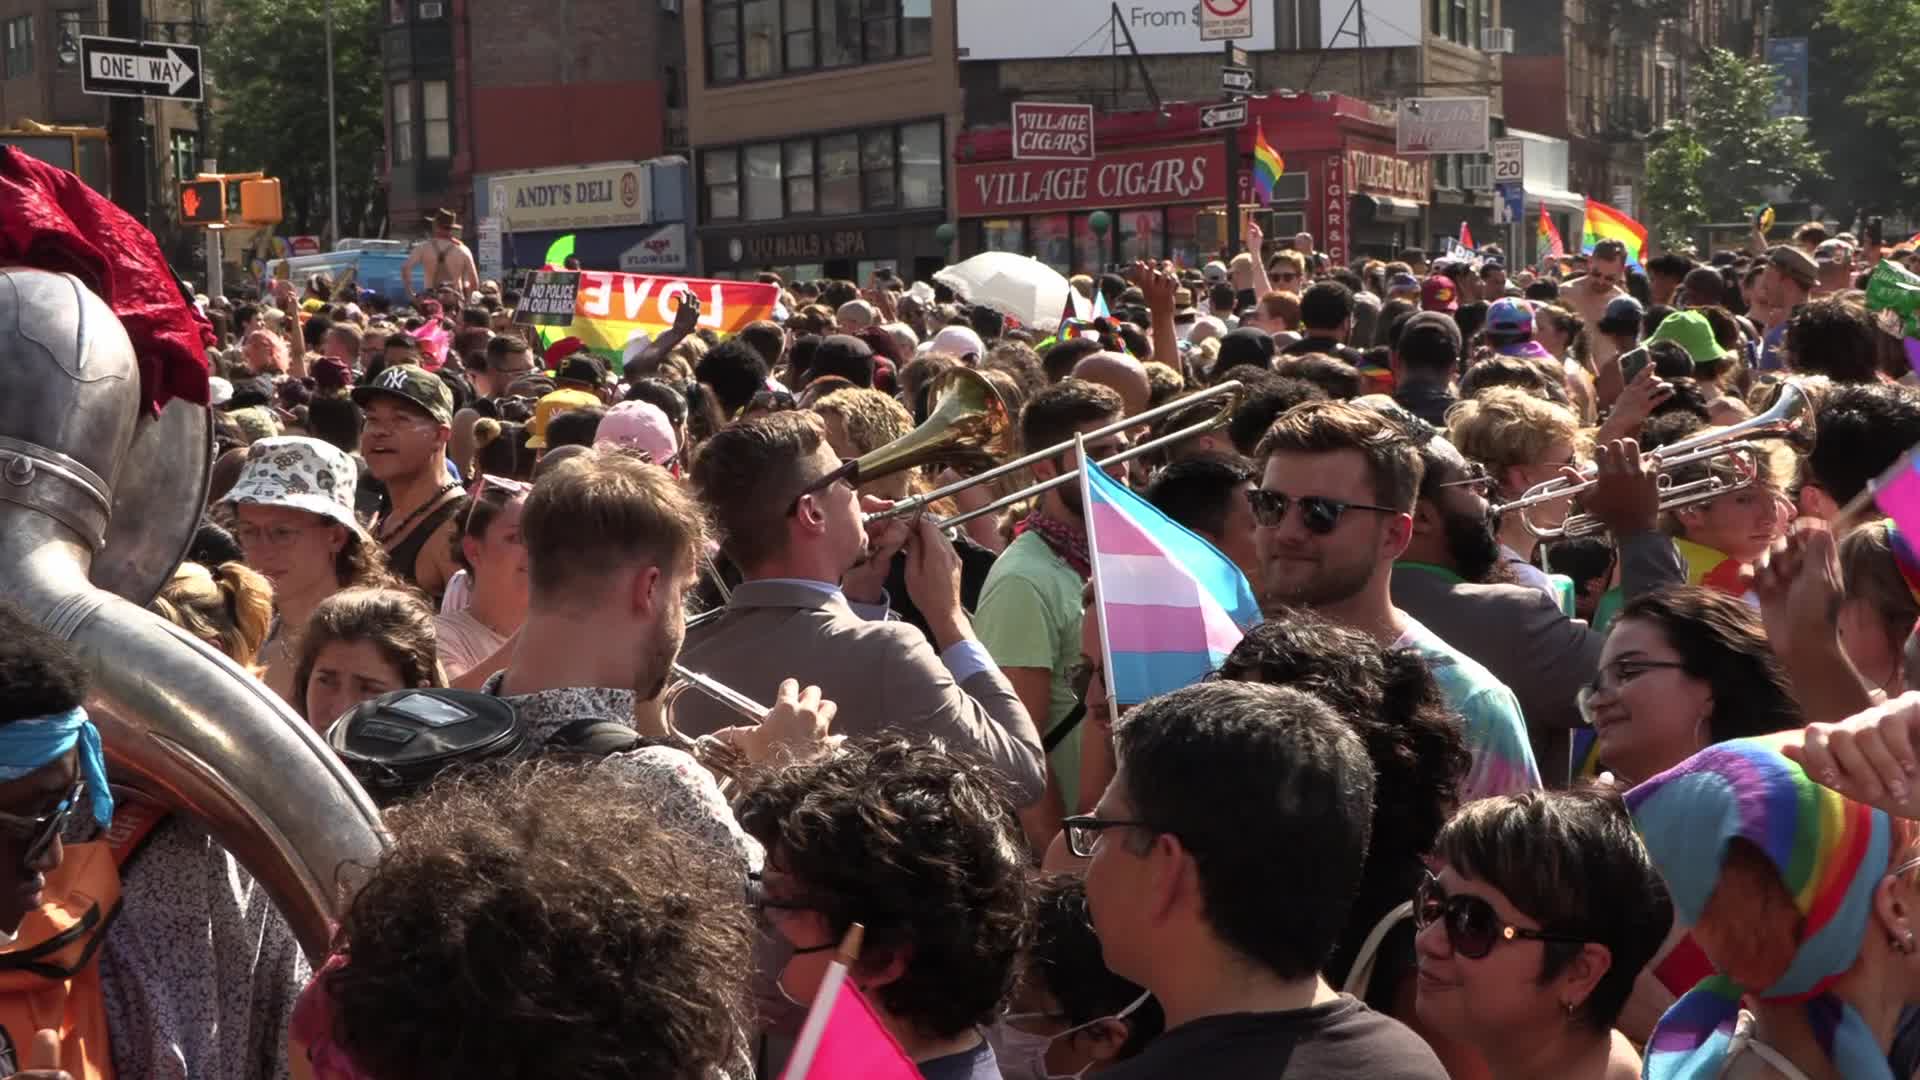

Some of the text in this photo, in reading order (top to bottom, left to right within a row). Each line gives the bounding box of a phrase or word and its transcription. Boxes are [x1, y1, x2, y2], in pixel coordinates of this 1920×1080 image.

[1131, 7, 1186, 27] From
[100, 55, 182, 82] ONE WAY
[1018, 113, 1089, 131] VILLAGE
[1020, 131, 1088, 155] CIGARS
[1497, 160, 1520, 177] 20
[975, 156, 1207, 205] VILLAGE CIGARS
[515, 179, 613, 209] ANDY'S DELI
[835, 231, 869, 256] SPA
[530, 284, 575, 299] NO POLICE
[519, 297, 531, 311] IN
[531, 298, 550, 312] OUR
